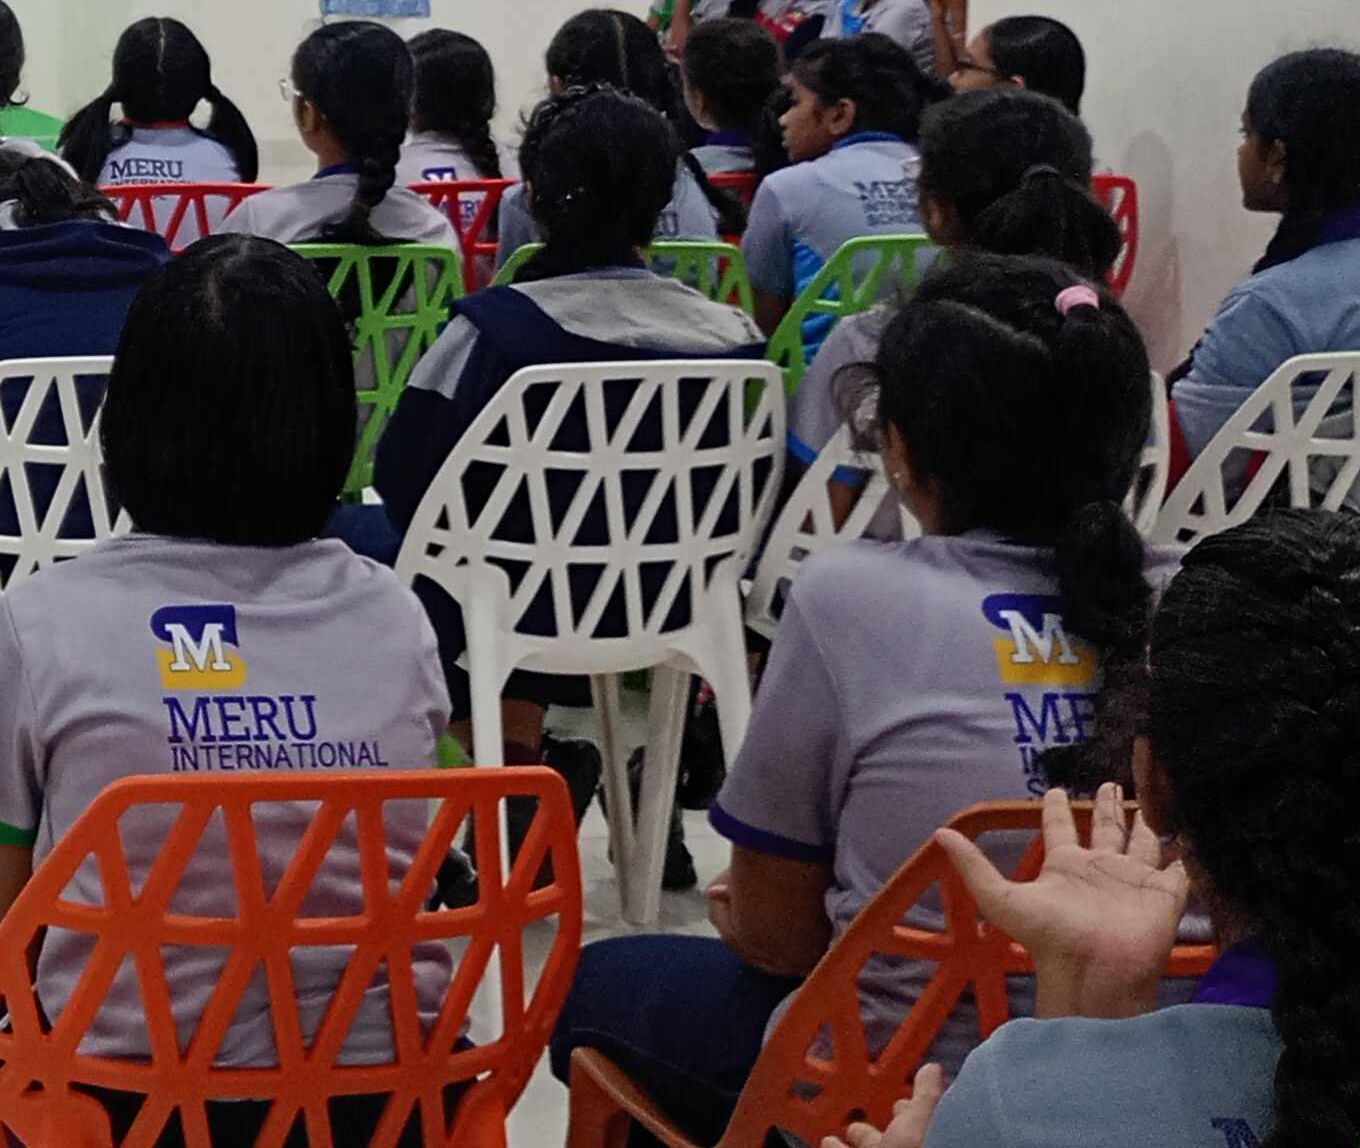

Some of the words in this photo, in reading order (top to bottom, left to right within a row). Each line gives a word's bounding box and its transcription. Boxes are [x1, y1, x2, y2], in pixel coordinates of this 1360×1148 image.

[109, 158, 183, 179] MERU
[165, 623, 231, 671] M
[999, 610, 1078, 664] M
[163, 695, 317, 743] MERU
[1004, 692, 1097, 743] ME
[172, 741, 389, 771] INTERNATIONAL
